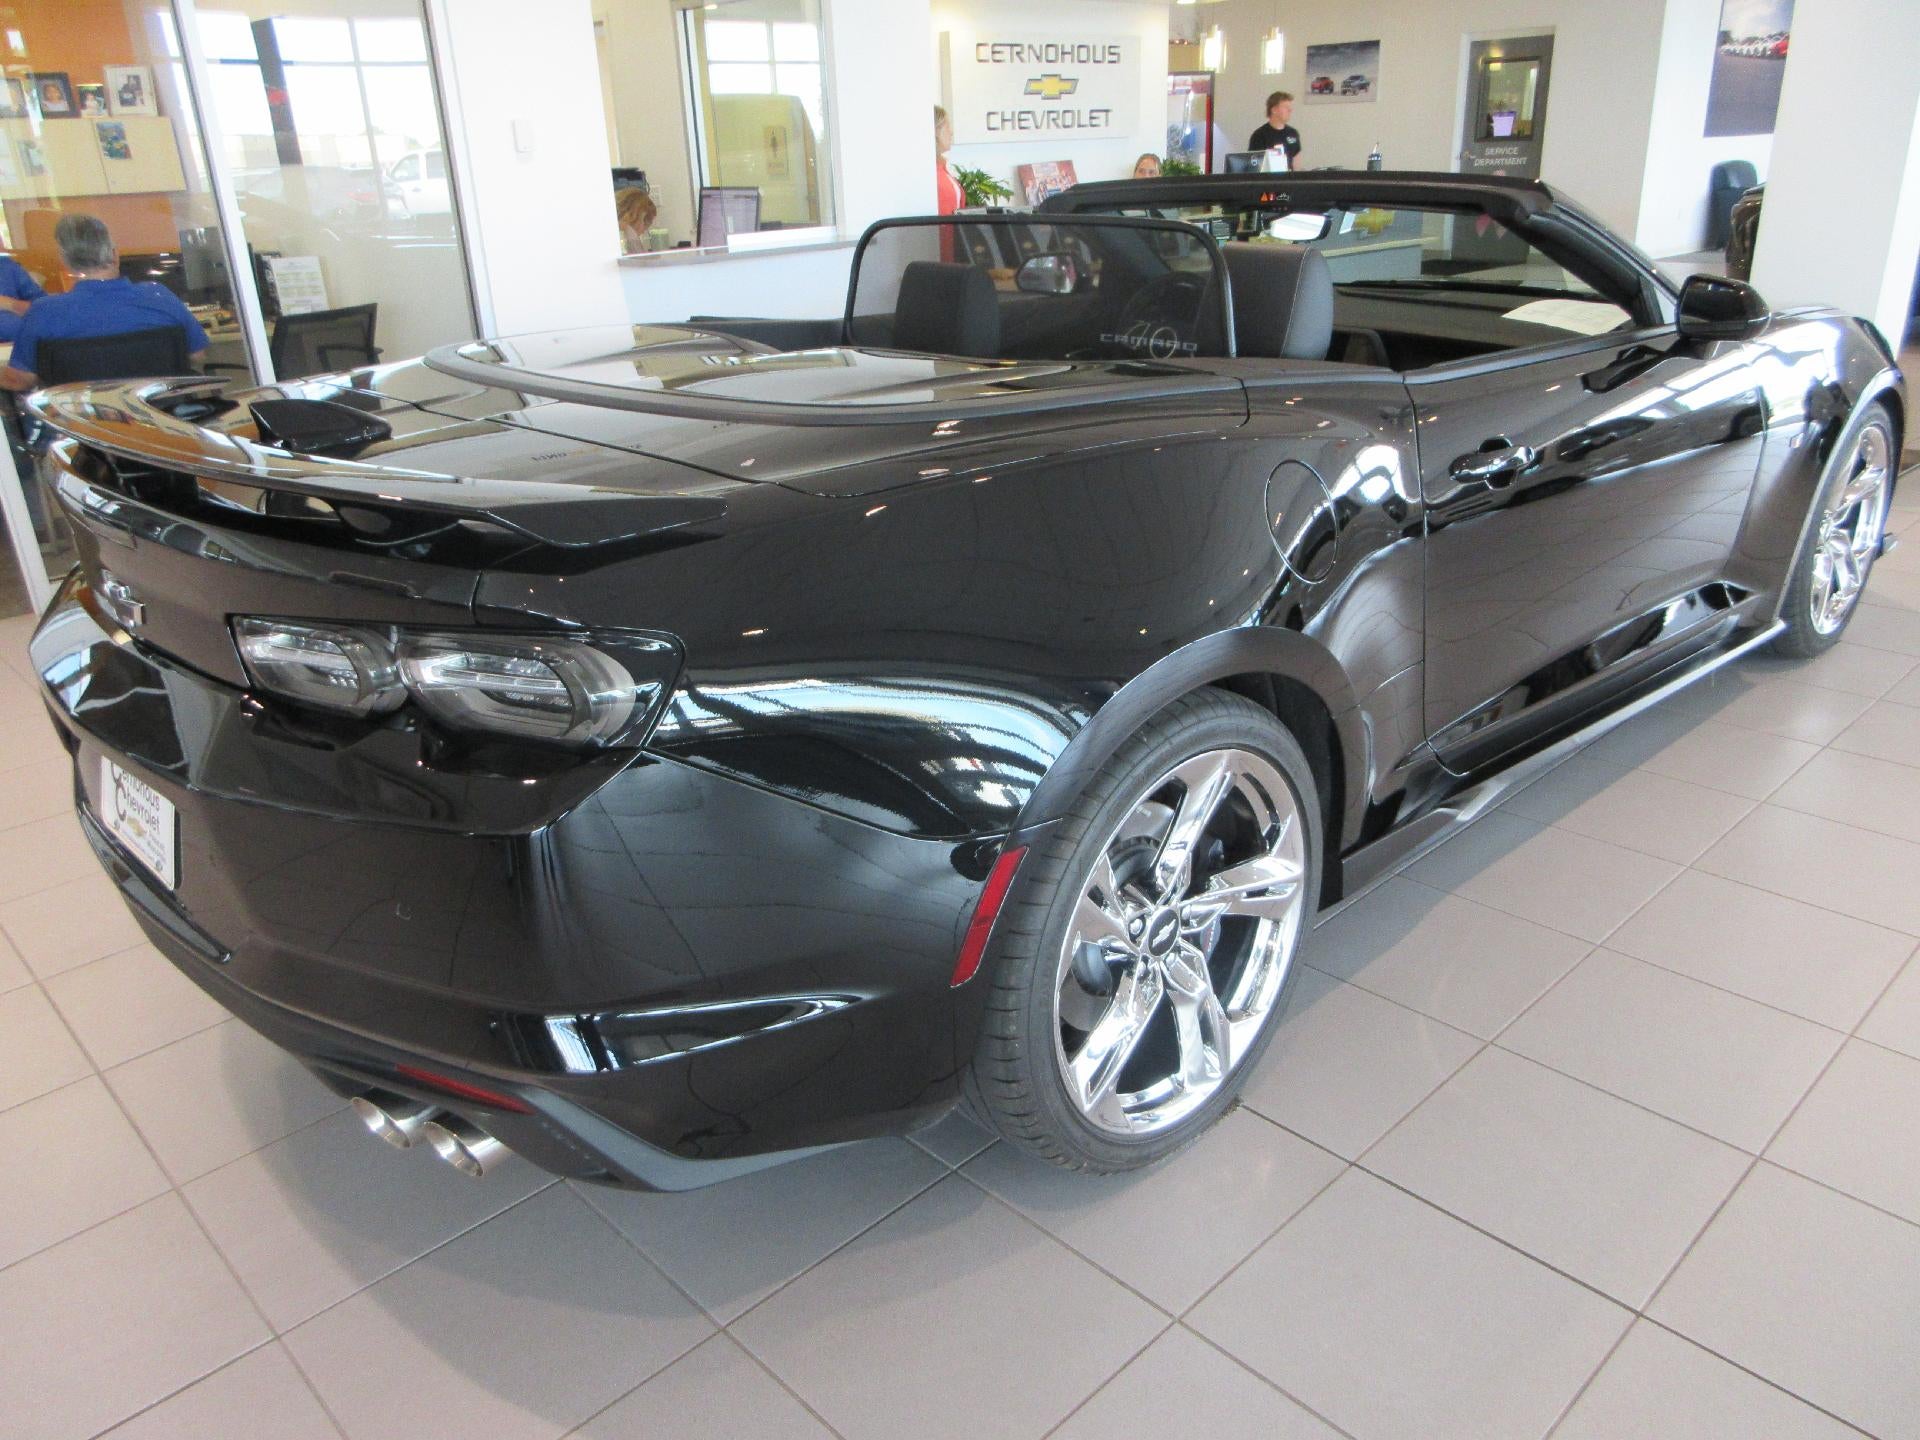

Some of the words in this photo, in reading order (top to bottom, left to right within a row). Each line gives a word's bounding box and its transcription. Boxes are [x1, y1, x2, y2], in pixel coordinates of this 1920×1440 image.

[975, 42, 1121, 64] CERNOHOUS
[986, 108, 1112, 131] CHEVROLET
[1485, 146, 1519, 156] SERVICE
[1474, 157, 1528, 167] DEPARTMENT
[1100, 333, 1198, 352] CAMARO
